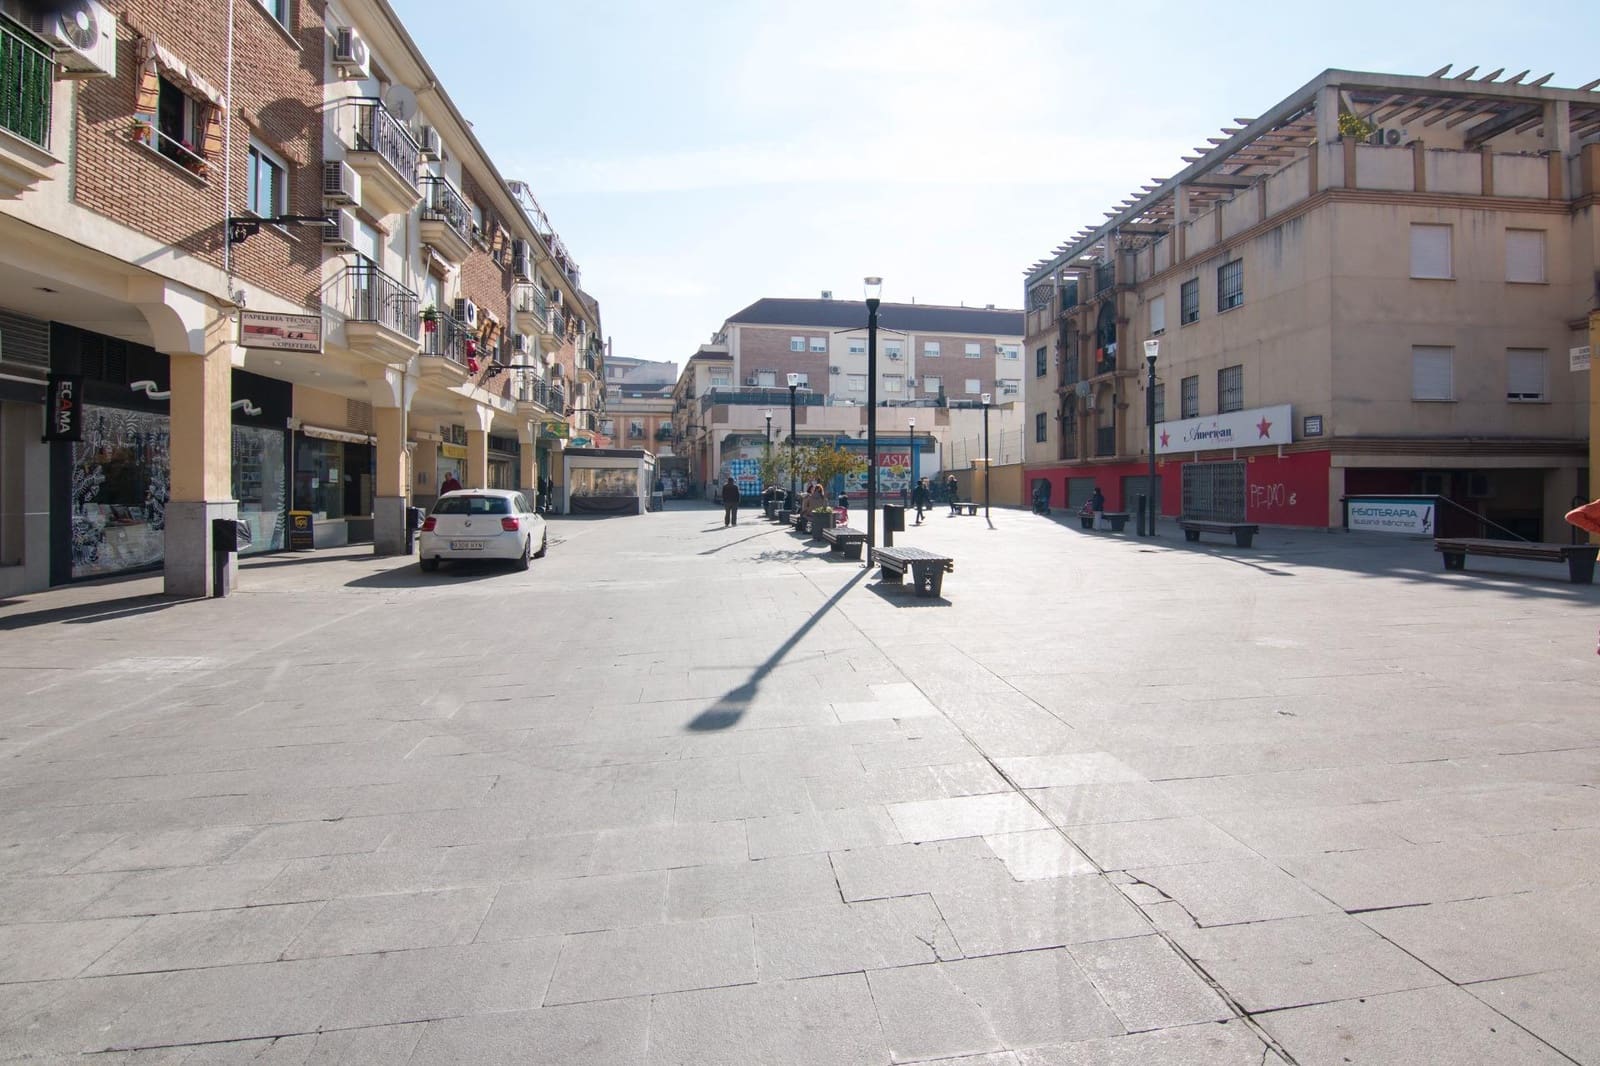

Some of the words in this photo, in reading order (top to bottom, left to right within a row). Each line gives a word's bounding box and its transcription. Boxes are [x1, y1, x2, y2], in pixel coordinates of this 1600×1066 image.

[59, 381, 73, 433] ECAMA
[1184, 423, 1232, 442] American
[881, 454, 911, 466] ASIA
